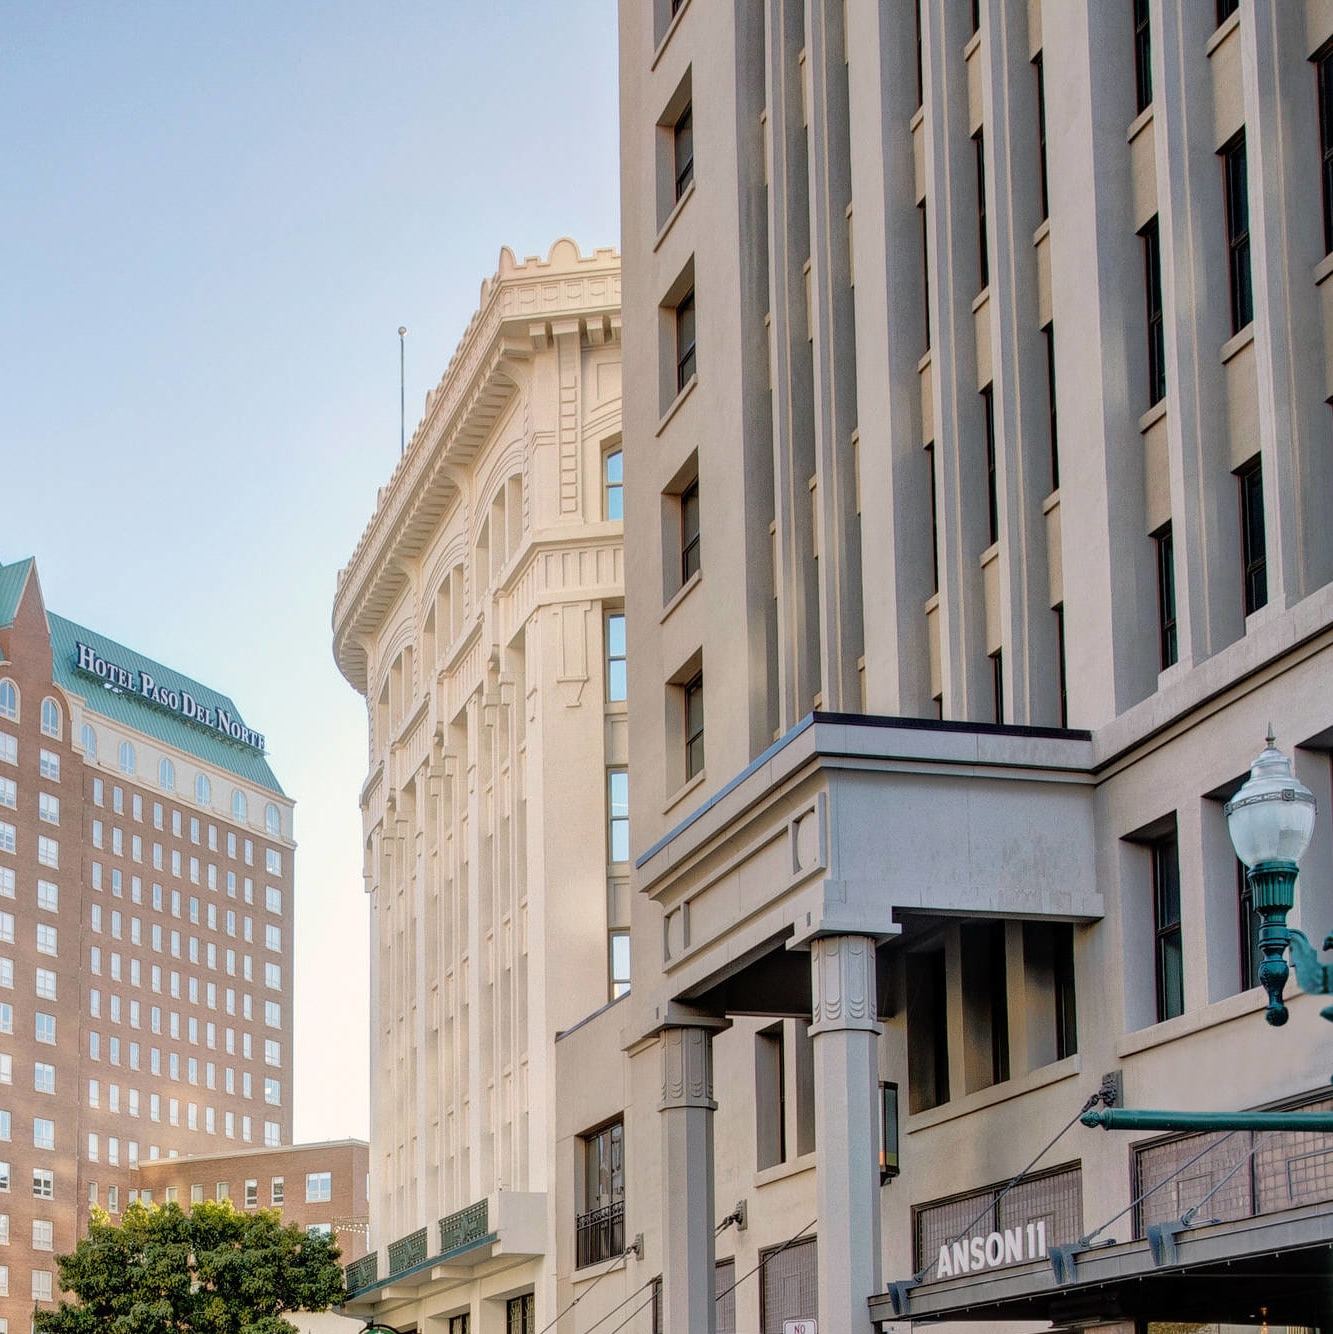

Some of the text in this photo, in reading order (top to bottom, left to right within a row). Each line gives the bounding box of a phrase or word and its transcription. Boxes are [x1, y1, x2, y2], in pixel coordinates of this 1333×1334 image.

[936, 1221, 1046, 1279] ANSON 11
[794, 1324, 805, 1334] NO
